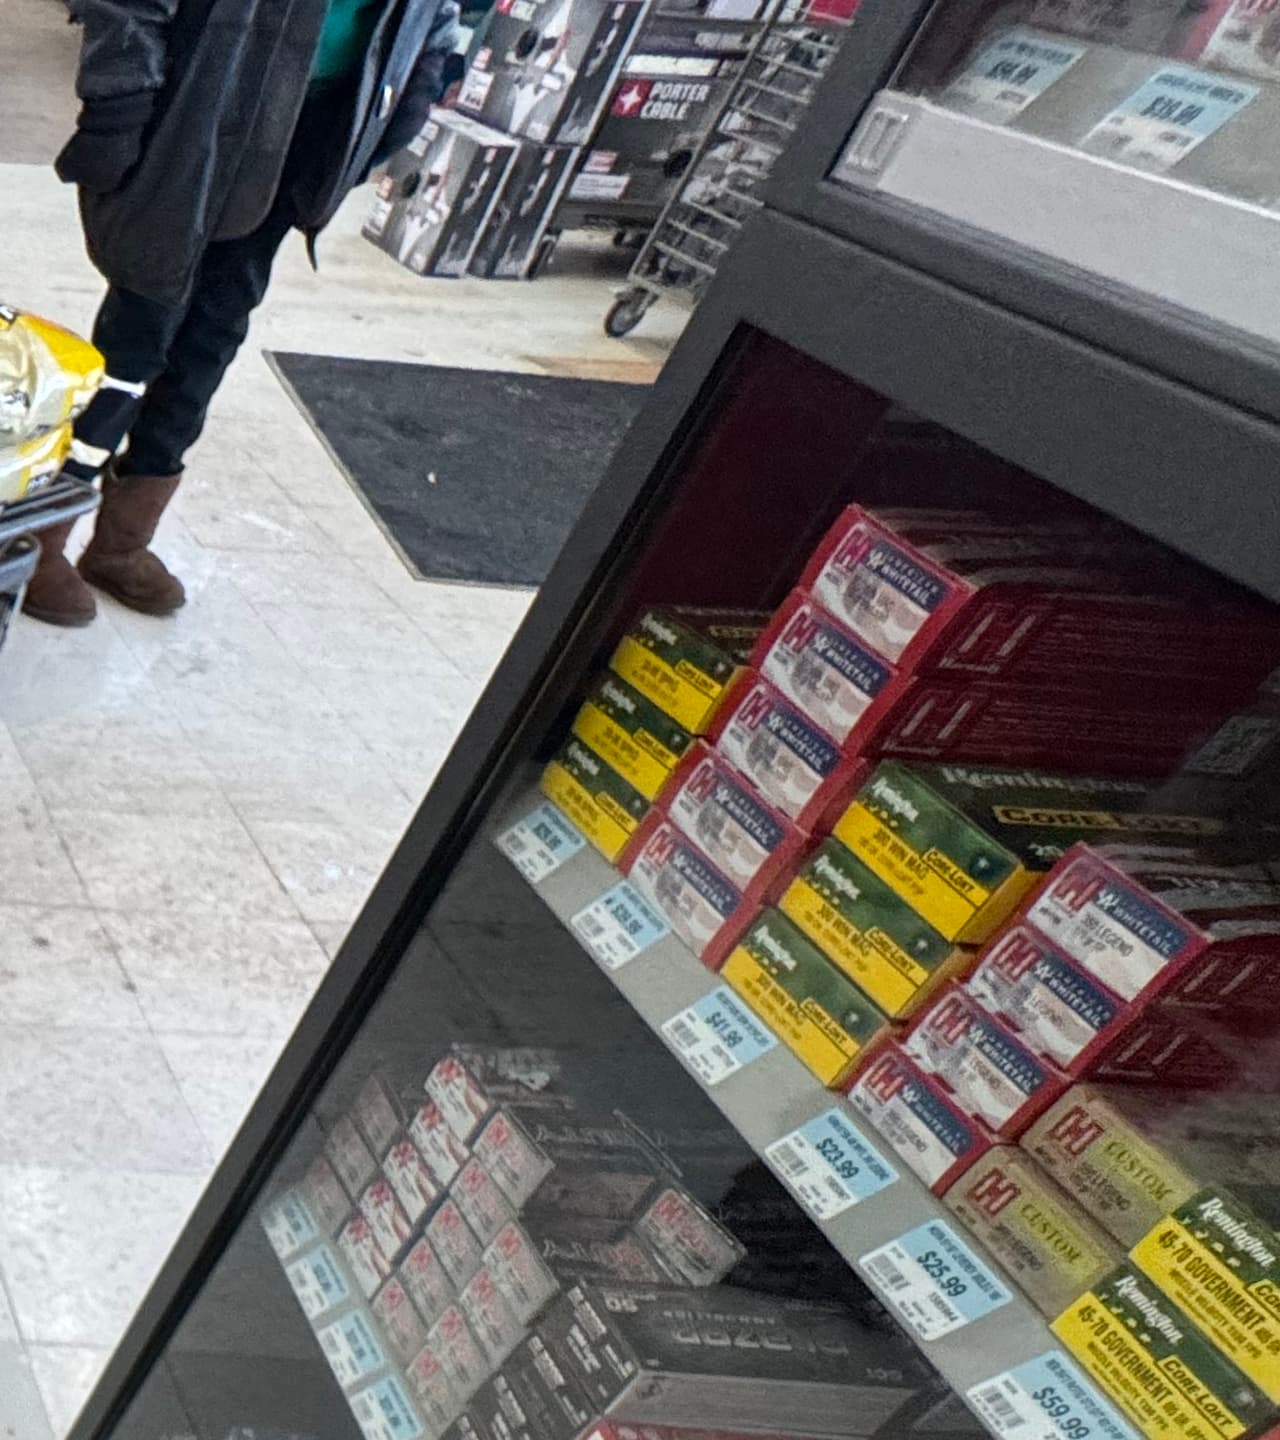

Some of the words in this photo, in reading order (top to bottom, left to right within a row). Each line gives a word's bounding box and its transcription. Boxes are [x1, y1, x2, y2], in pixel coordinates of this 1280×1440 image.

[640, 102, 692, 120] CABLE
[651, 82, 710, 102] PORTER
[1108, 900, 1173, 957] WHITETAIL
[1046, 972, 1104, 1028] WHITETAIL
[703, 1008, 744, 1052] $41.99
[980, 1040, 1034, 1095] WHITETAIL
[912, 1103, 963, 1153] WHITETAIL
[816, 1136, 860, 1181] $23.99
[1102, 1139, 1175, 1201] CUSTOM
[1019, 1202, 1083, 1264] CUSTOM
[1198, 1196, 1277, 1268] Remington
[916, 1250, 968, 1298] $25.99
[1157, 1229, 1193, 1265] 45-70
[1188, 1255, 1266, 1332] GOVERNMENT
[1114, 1274, 1184, 1345] Remington
[1077, 1303, 1108, 1339] 45-70
[1102, 1330, 1174, 1404] GOVERNMENT
[1032, 1386, 1091, 1440] $59.99
[1162, 1356, 1234, 1428] CORE-LOKT
